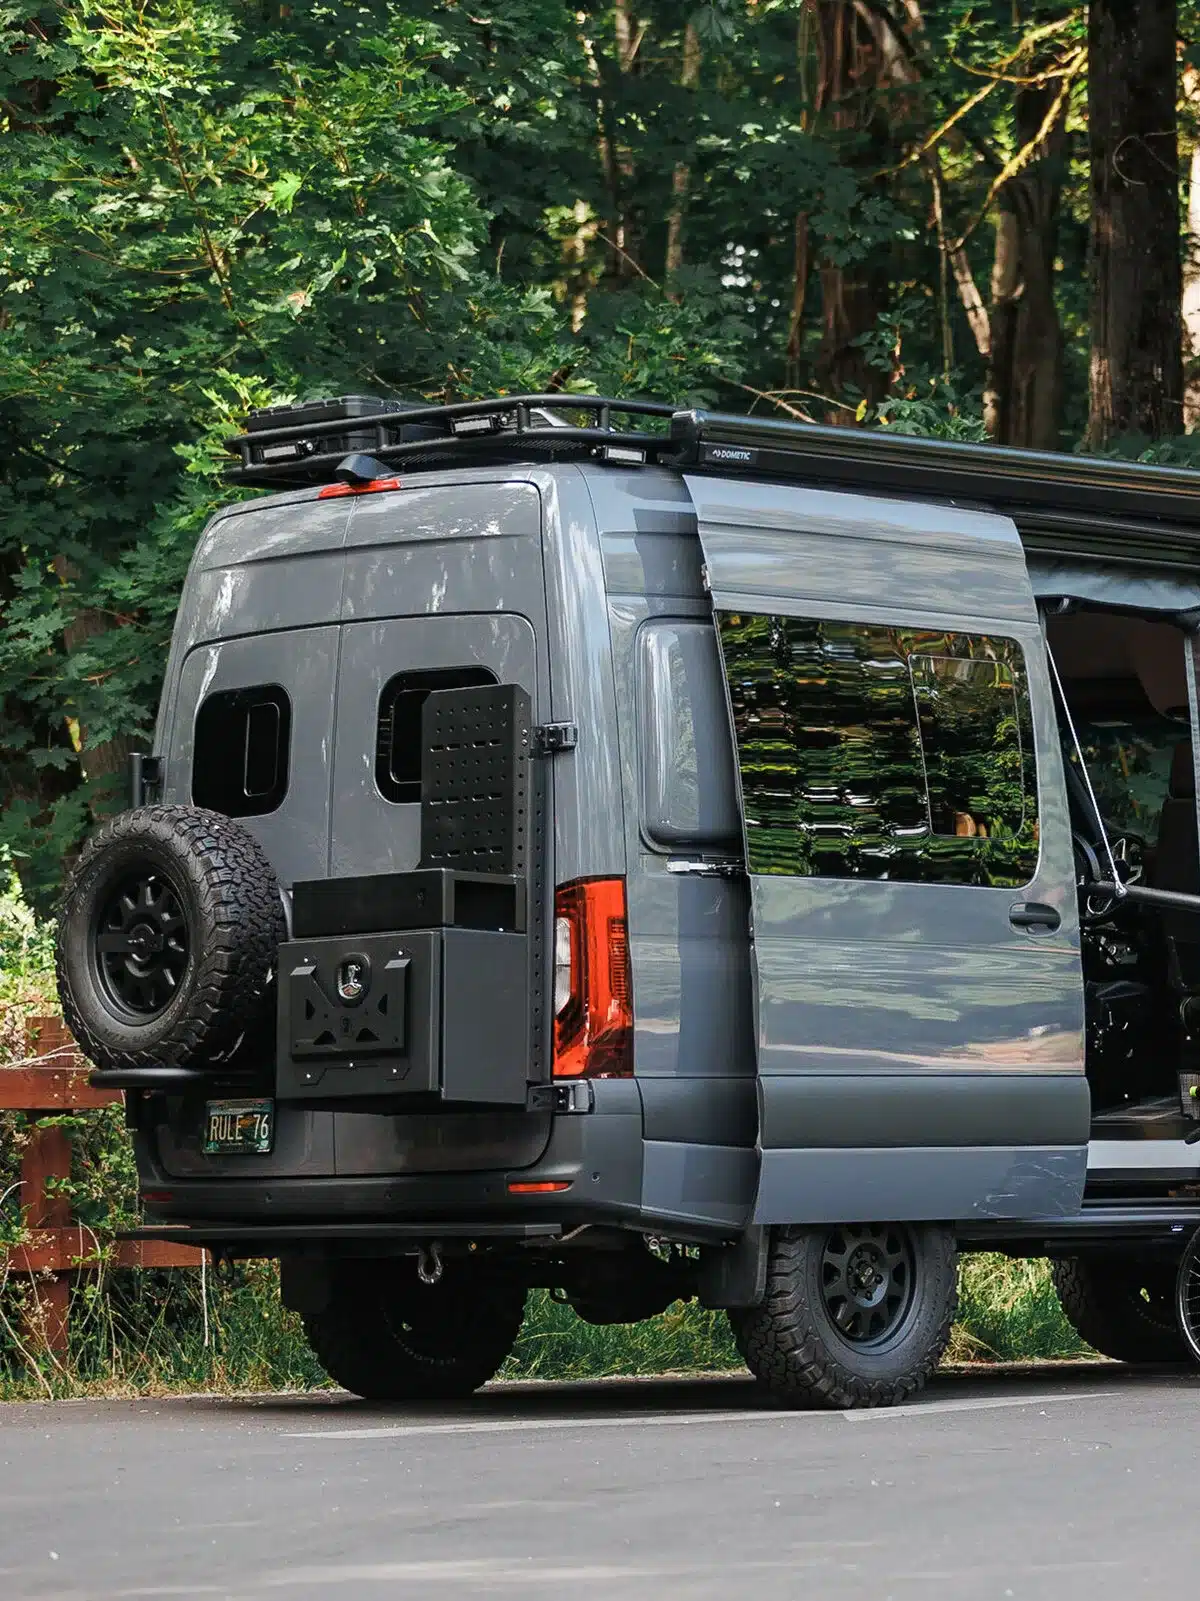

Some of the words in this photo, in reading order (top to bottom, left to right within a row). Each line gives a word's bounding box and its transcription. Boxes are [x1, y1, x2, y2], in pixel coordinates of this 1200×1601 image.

[720, 450, 751, 460] DOMETIC
[209, 1114, 244, 1141] RULE
[253, 1113, 269, 1140] 76
